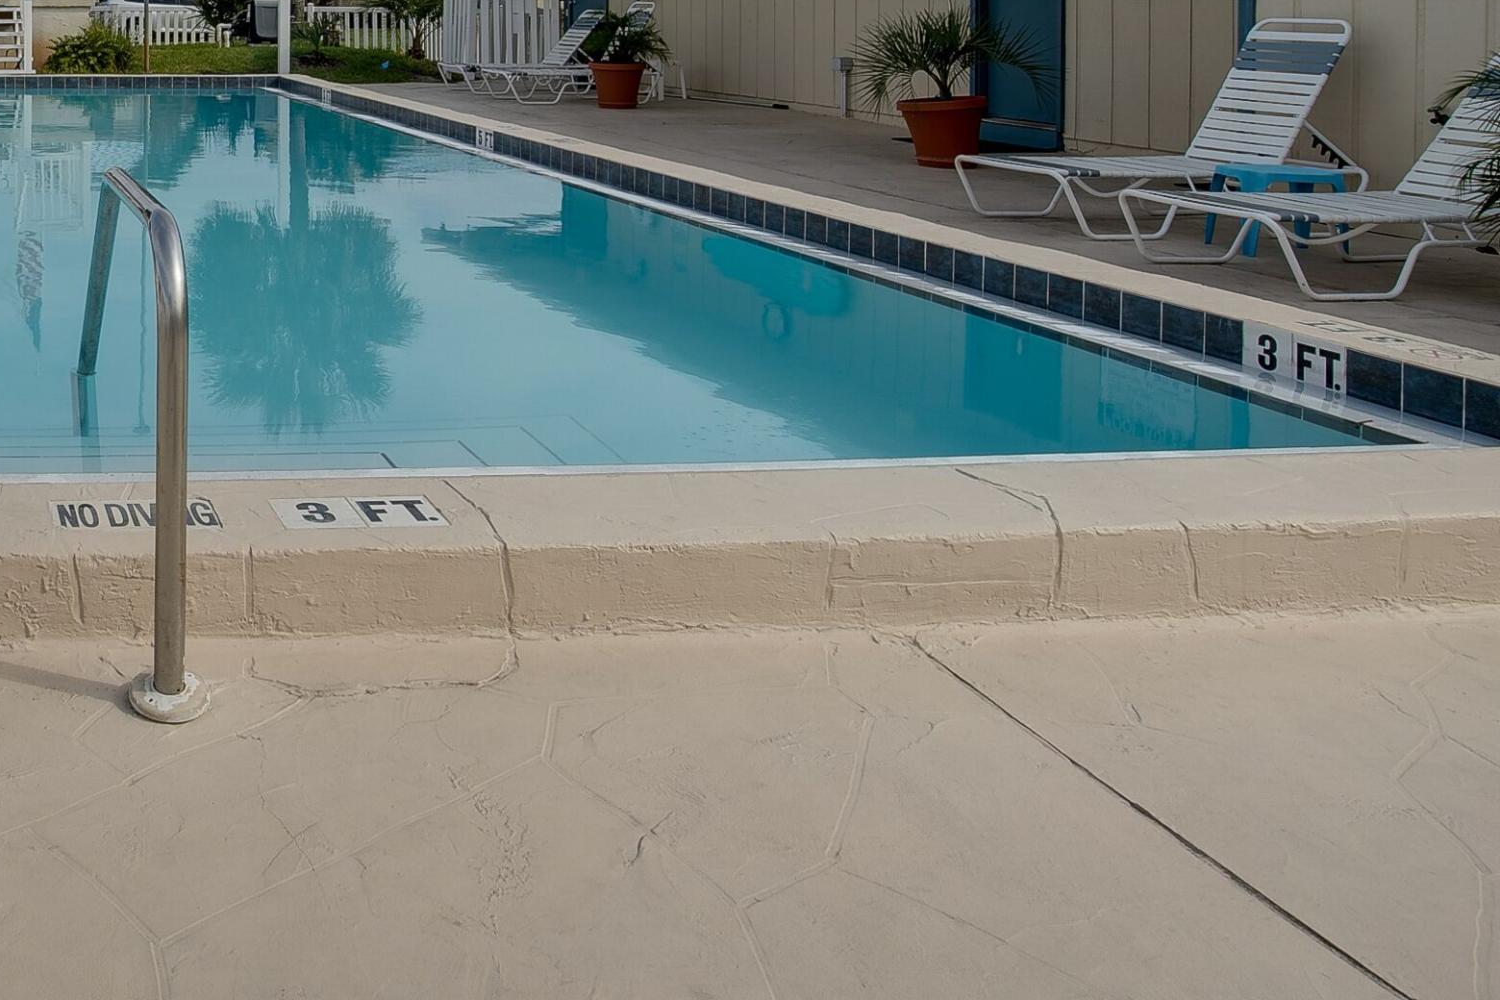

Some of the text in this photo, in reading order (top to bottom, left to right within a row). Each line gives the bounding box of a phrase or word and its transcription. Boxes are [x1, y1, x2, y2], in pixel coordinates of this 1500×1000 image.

[478, 130, 483, 146] 5
[1257, 334, 1341, 391] 3 FT.
[56, 502, 219, 527] NO DIVG
[295, 500, 439, 523] 3 FT.
